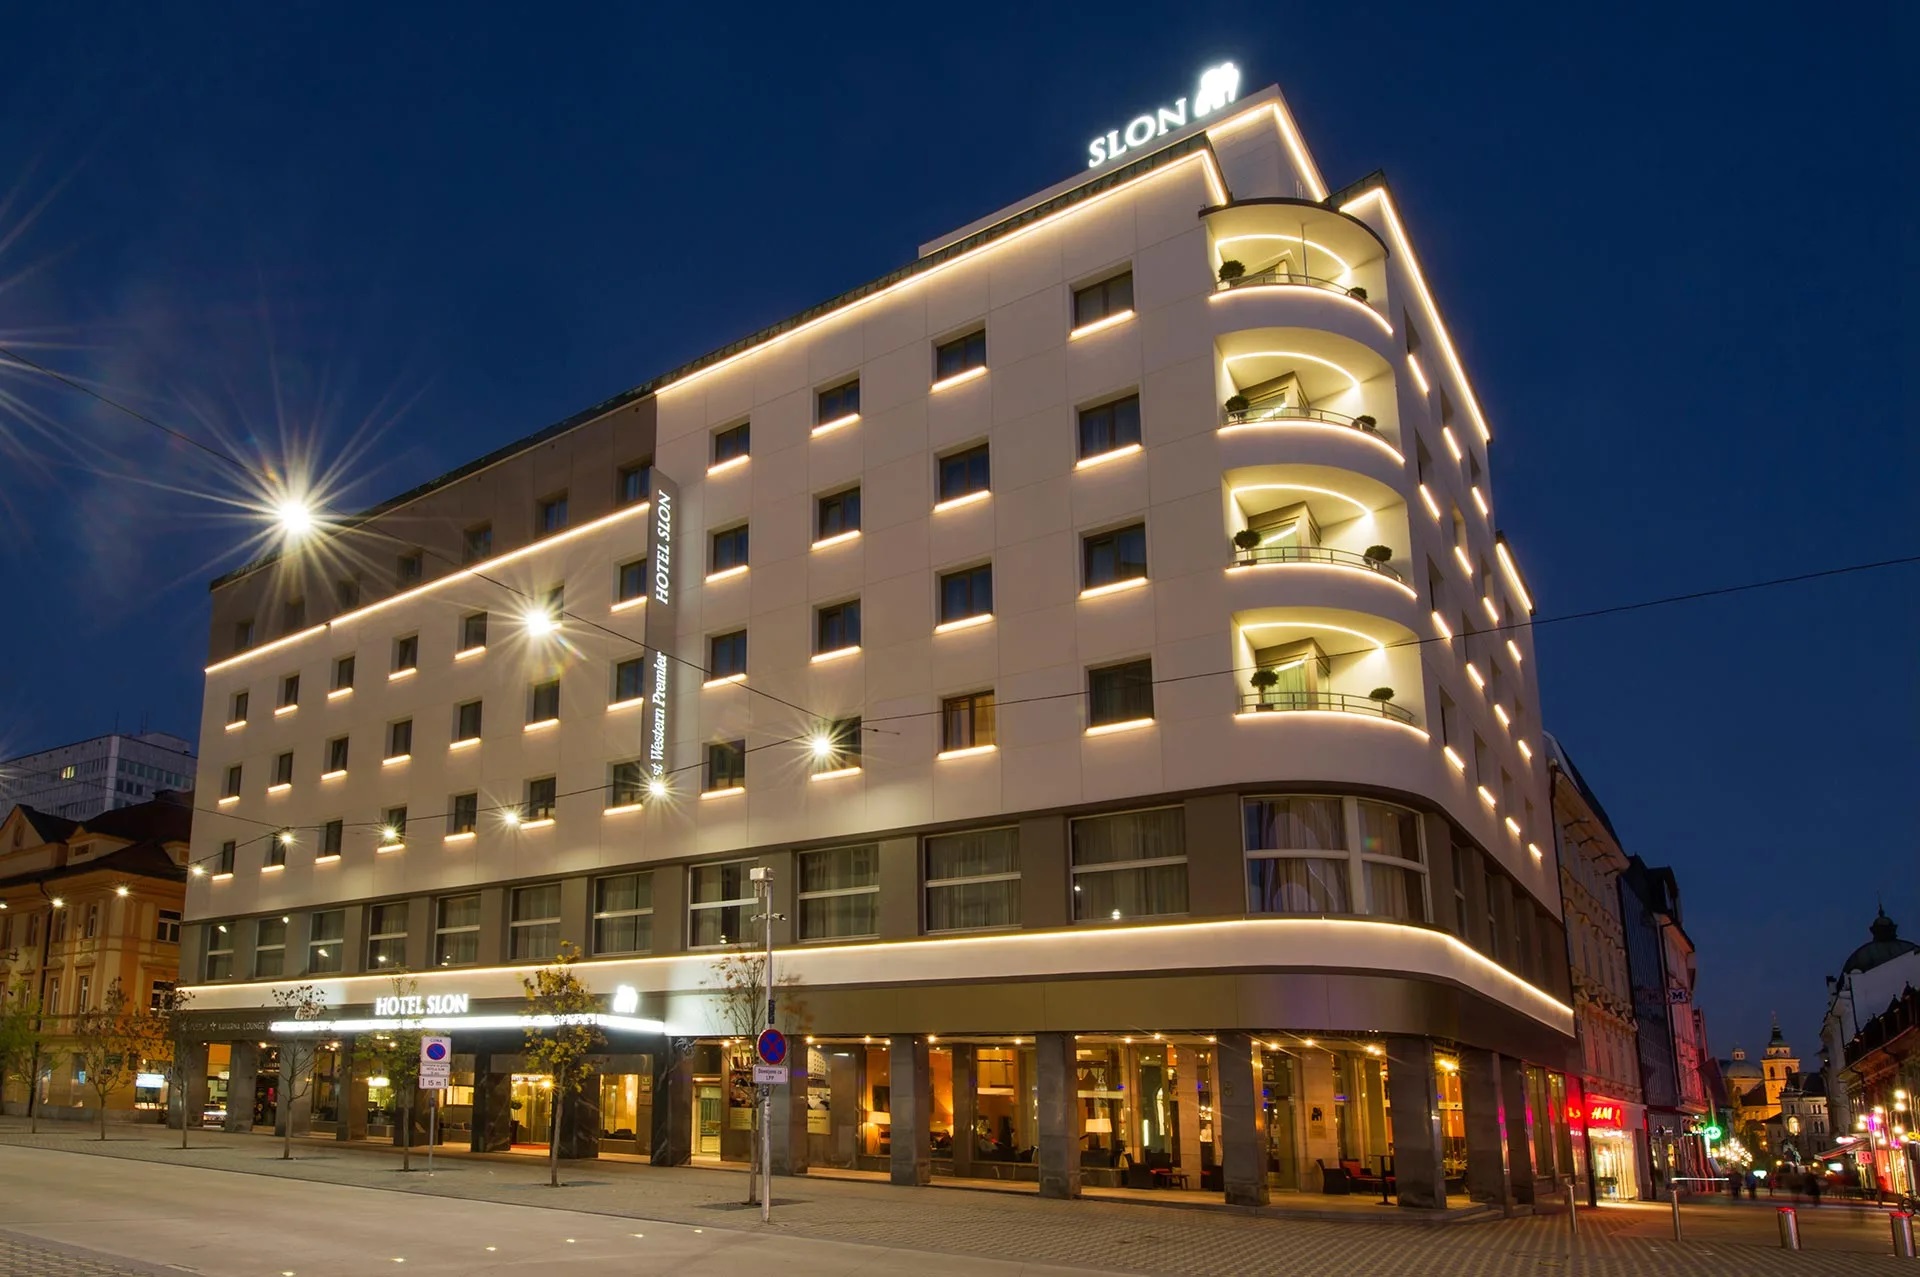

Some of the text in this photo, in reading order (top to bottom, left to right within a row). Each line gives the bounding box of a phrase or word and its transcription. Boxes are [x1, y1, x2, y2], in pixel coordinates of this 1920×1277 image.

[1088, 98, 1187, 168] SLON
[655, 489, 671, 605] HOTEL SLON
[652, 651, 667, 708] Premier
[650, 709, 665, 761] Western
[375, 993, 468, 1015] HOTEL SLON
